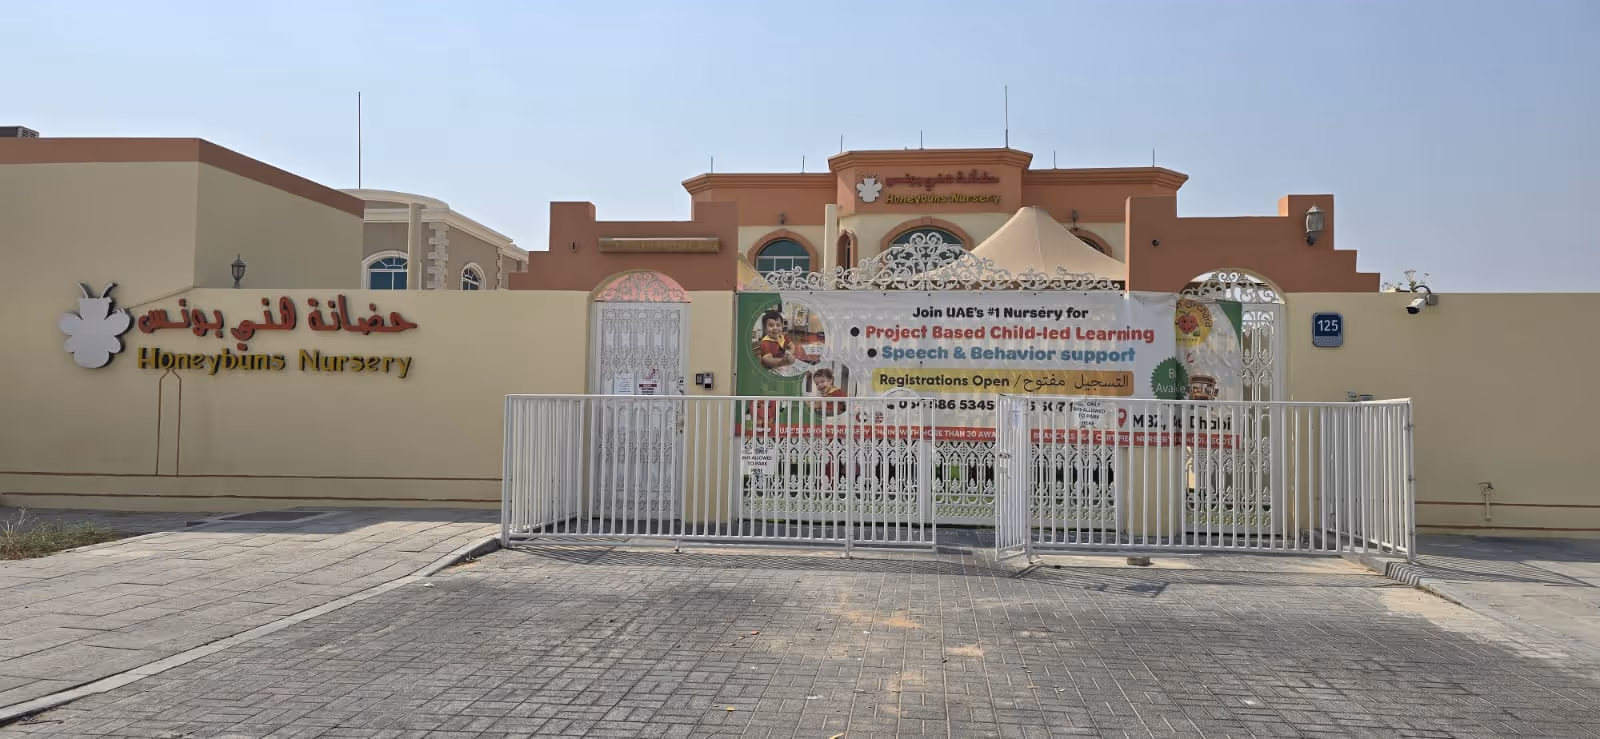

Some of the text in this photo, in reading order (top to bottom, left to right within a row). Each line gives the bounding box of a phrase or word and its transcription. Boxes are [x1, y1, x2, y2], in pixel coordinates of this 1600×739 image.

[885, 193, 1000, 207] Honeybuns Nursery
[912, 306, 1089, 321] Join UAE's #1 Nursery for
[137, 294, 418, 351] حضانة هني بونس
[1317, 319, 1338, 332] 125
[865, 324, 1155, 344] Project Based Child-led Learning
[881, 345, 1136, 364] Speech & Behavior support
[137, 347, 413, 379] Honeybuns Nursery
[879, 374, 969, 387] Registrations
[972, 375, 1010, 389] Open
[1023, 374, 1129, 392] التسجيل مفتوح
[959, 399, 995, 410] 5345
